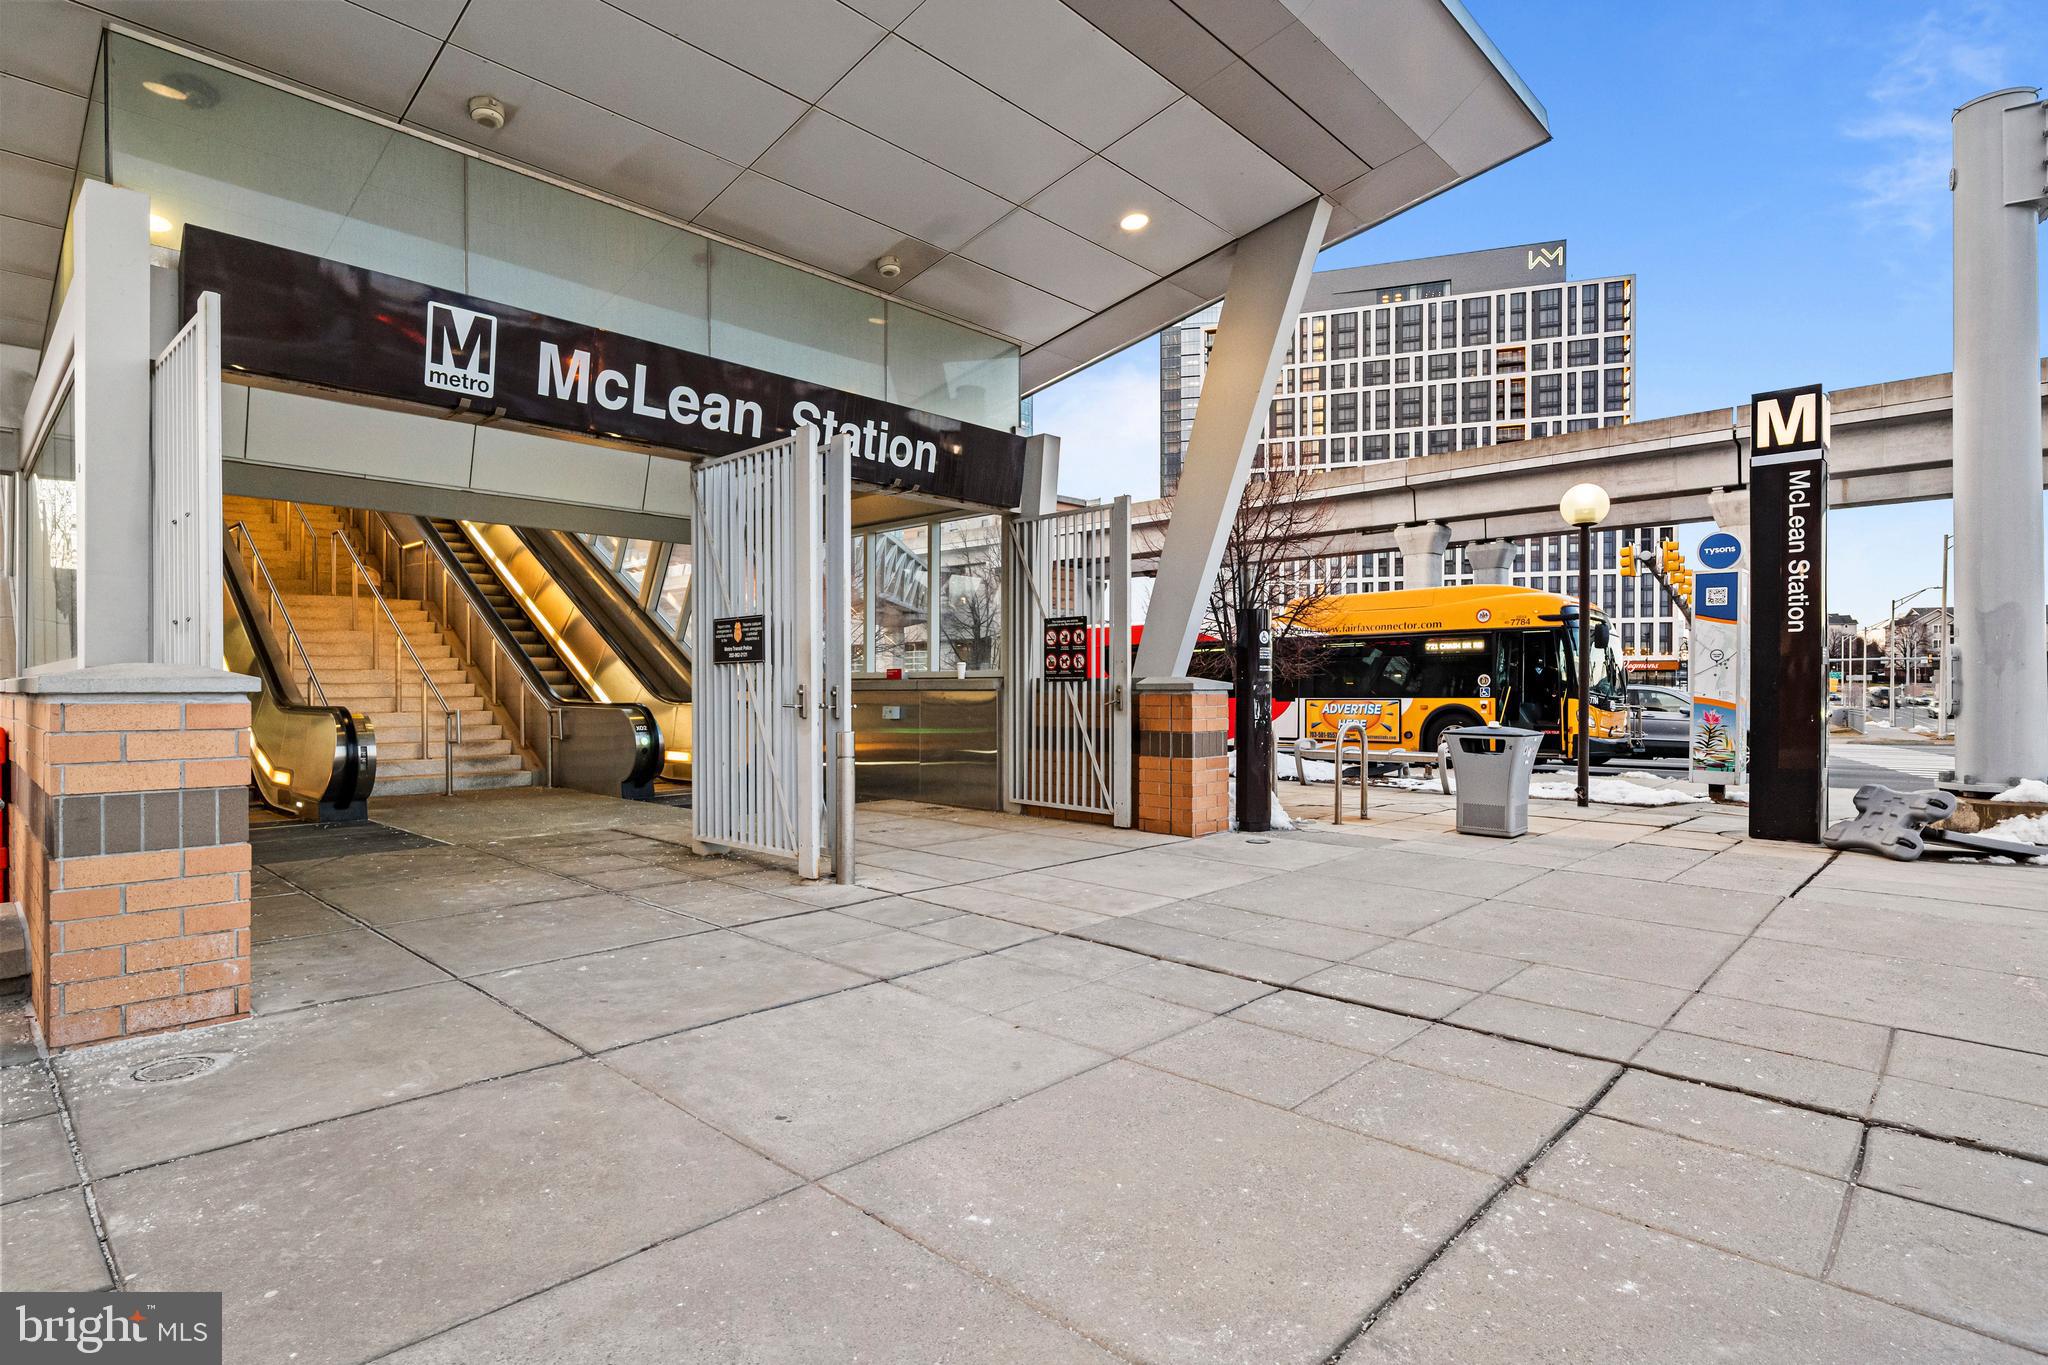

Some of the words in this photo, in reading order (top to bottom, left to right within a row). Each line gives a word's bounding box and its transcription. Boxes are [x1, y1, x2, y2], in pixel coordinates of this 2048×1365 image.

[430, 305, 493, 375] M
[429, 370, 490, 393] metro
[537, 341, 763, 438] McLean
[790, 401, 937, 474] Station
[1757, 393, 1816, 449] M
[1788, 469, 1811, 553] McLean
[1510, 618, 1531, 626] 7784
[1787, 559, 1811, 633] Station
[1322, 703, 1382, 715] ADVERTISE
[1337, 719, 1368, 731] HRE
